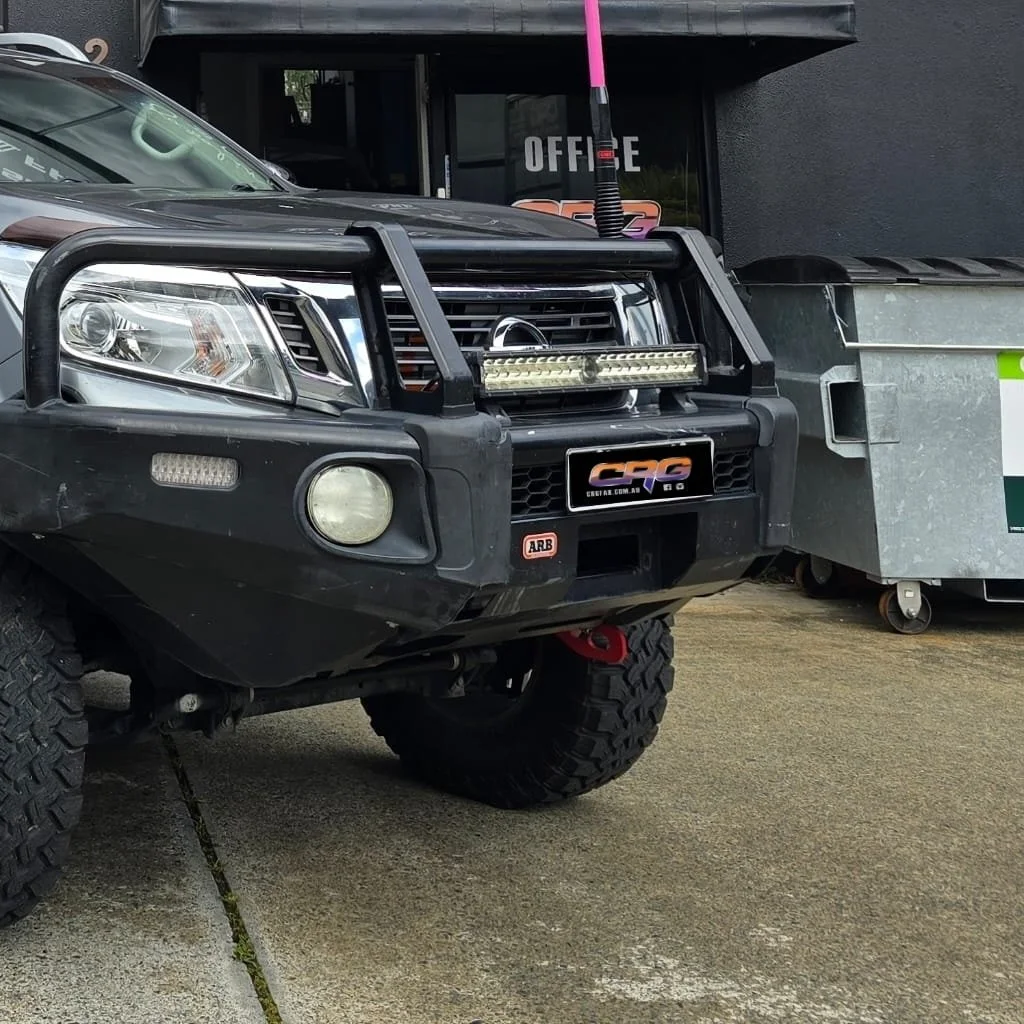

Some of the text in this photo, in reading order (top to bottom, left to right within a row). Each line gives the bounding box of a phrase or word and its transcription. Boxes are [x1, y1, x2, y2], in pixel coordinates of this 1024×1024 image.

[84, 37, 109, 65] 2
[588, 456, 693, 494] CRG
[528, 539, 553, 554] ARB
